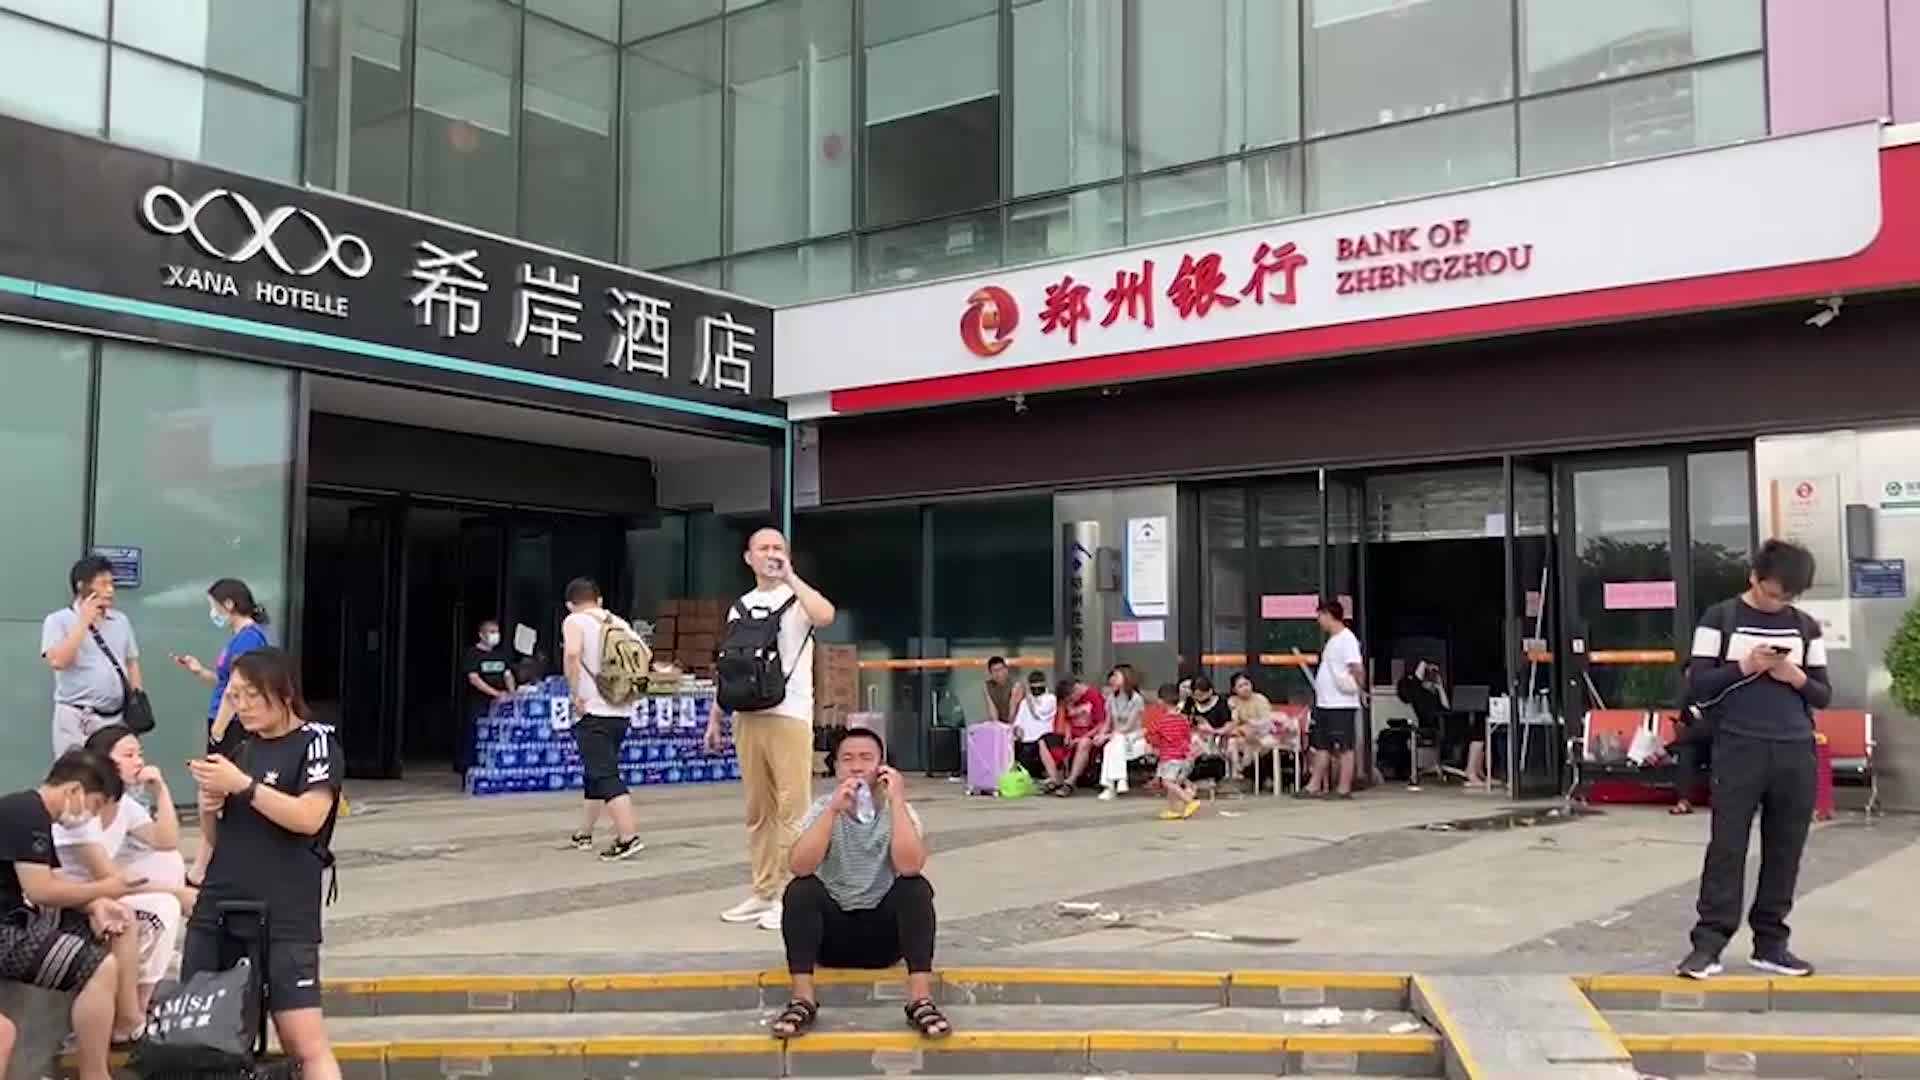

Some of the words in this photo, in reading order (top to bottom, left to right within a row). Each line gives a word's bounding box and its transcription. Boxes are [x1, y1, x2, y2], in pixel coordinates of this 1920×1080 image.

[1336, 226, 1420, 261] BANK
[1427, 218, 1470, 248] OF
[163, 264, 240, 297] XANA
[255, 280, 350, 318] HOTELLE
[1038, 242, 1308, 345] 郑州银行
[1336, 243, 1534, 295] ZHENGZHOU
[410, 240, 756, 396] 希岸酒店
